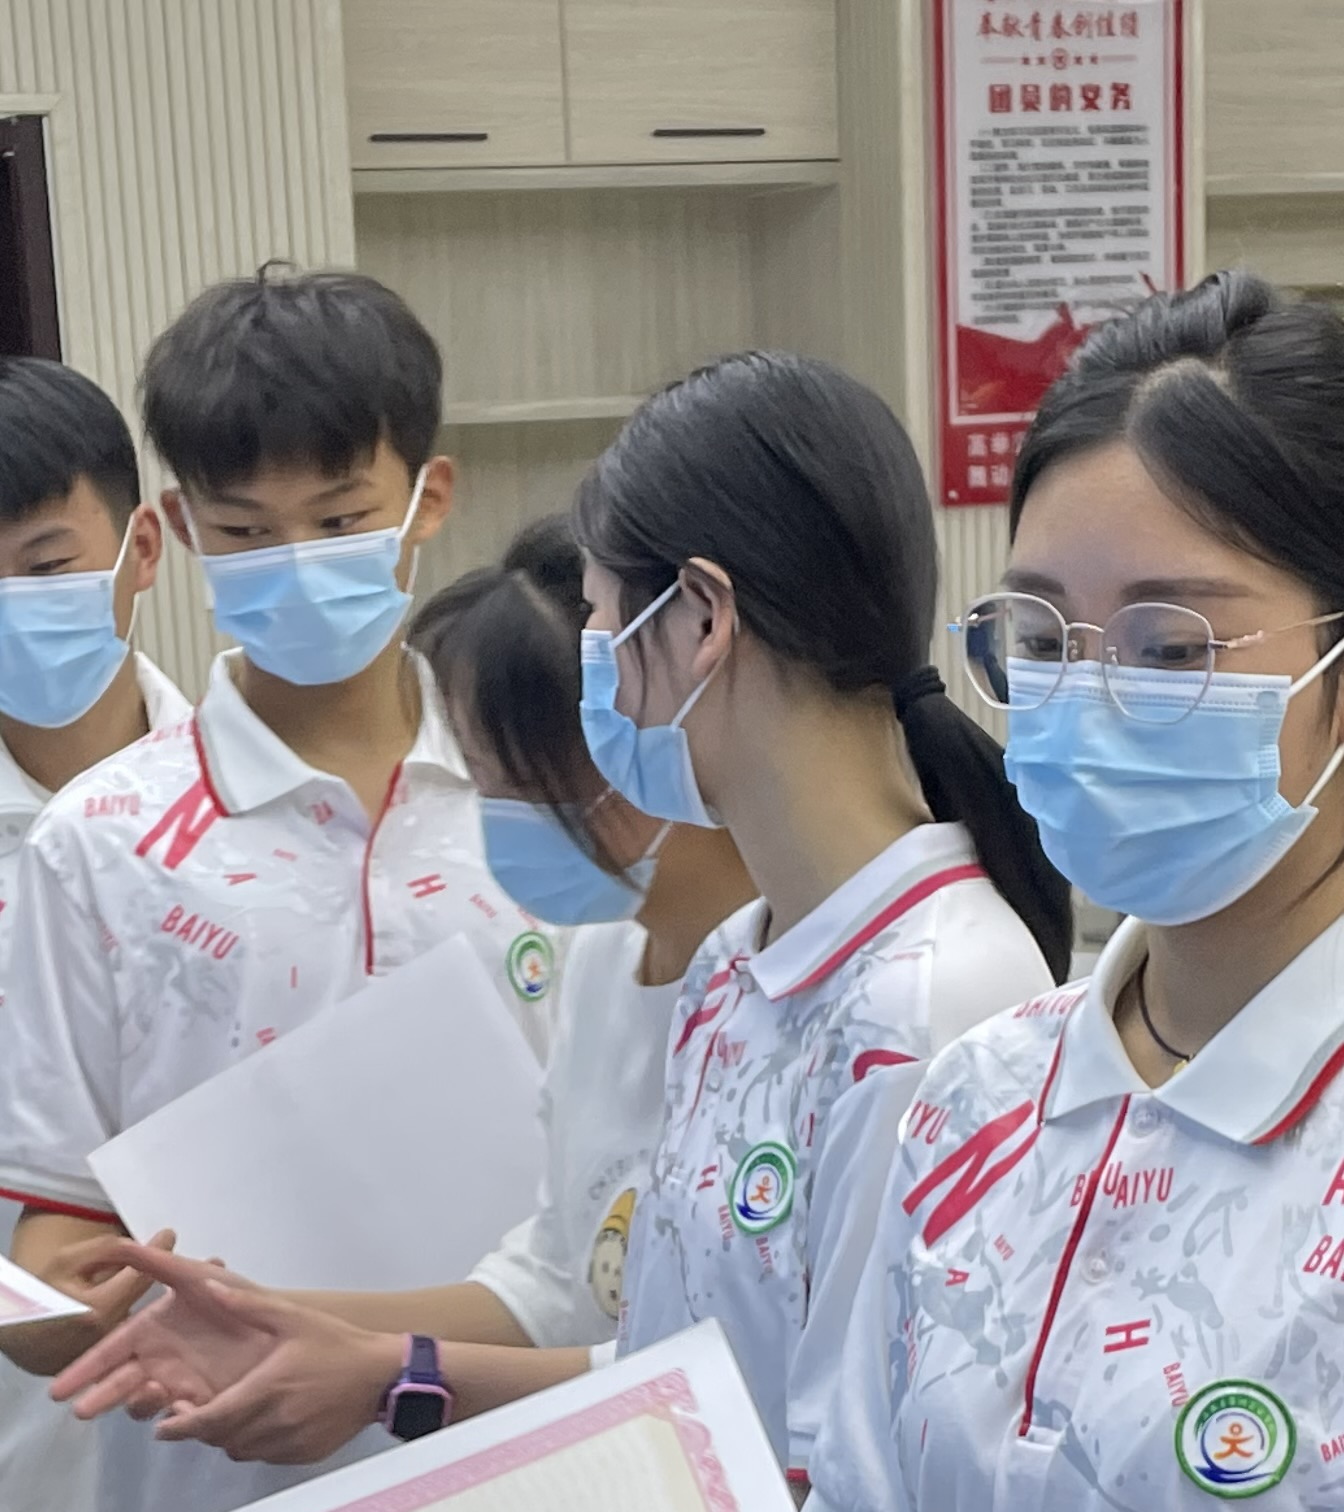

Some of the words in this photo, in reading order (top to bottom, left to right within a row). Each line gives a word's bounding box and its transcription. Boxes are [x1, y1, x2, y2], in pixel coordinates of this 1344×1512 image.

[83, 794, 142, 819] BAIYU
[405, 872, 450, 900] H
[161, 903, 242, 964] BAIYU
[902, 1099, 1044, 1249] N
[944, 1267, 970, 1287] A
[1103, 1318, 1152, 1353] H
[1162, 1362, 1190, 1408] BAIYU
